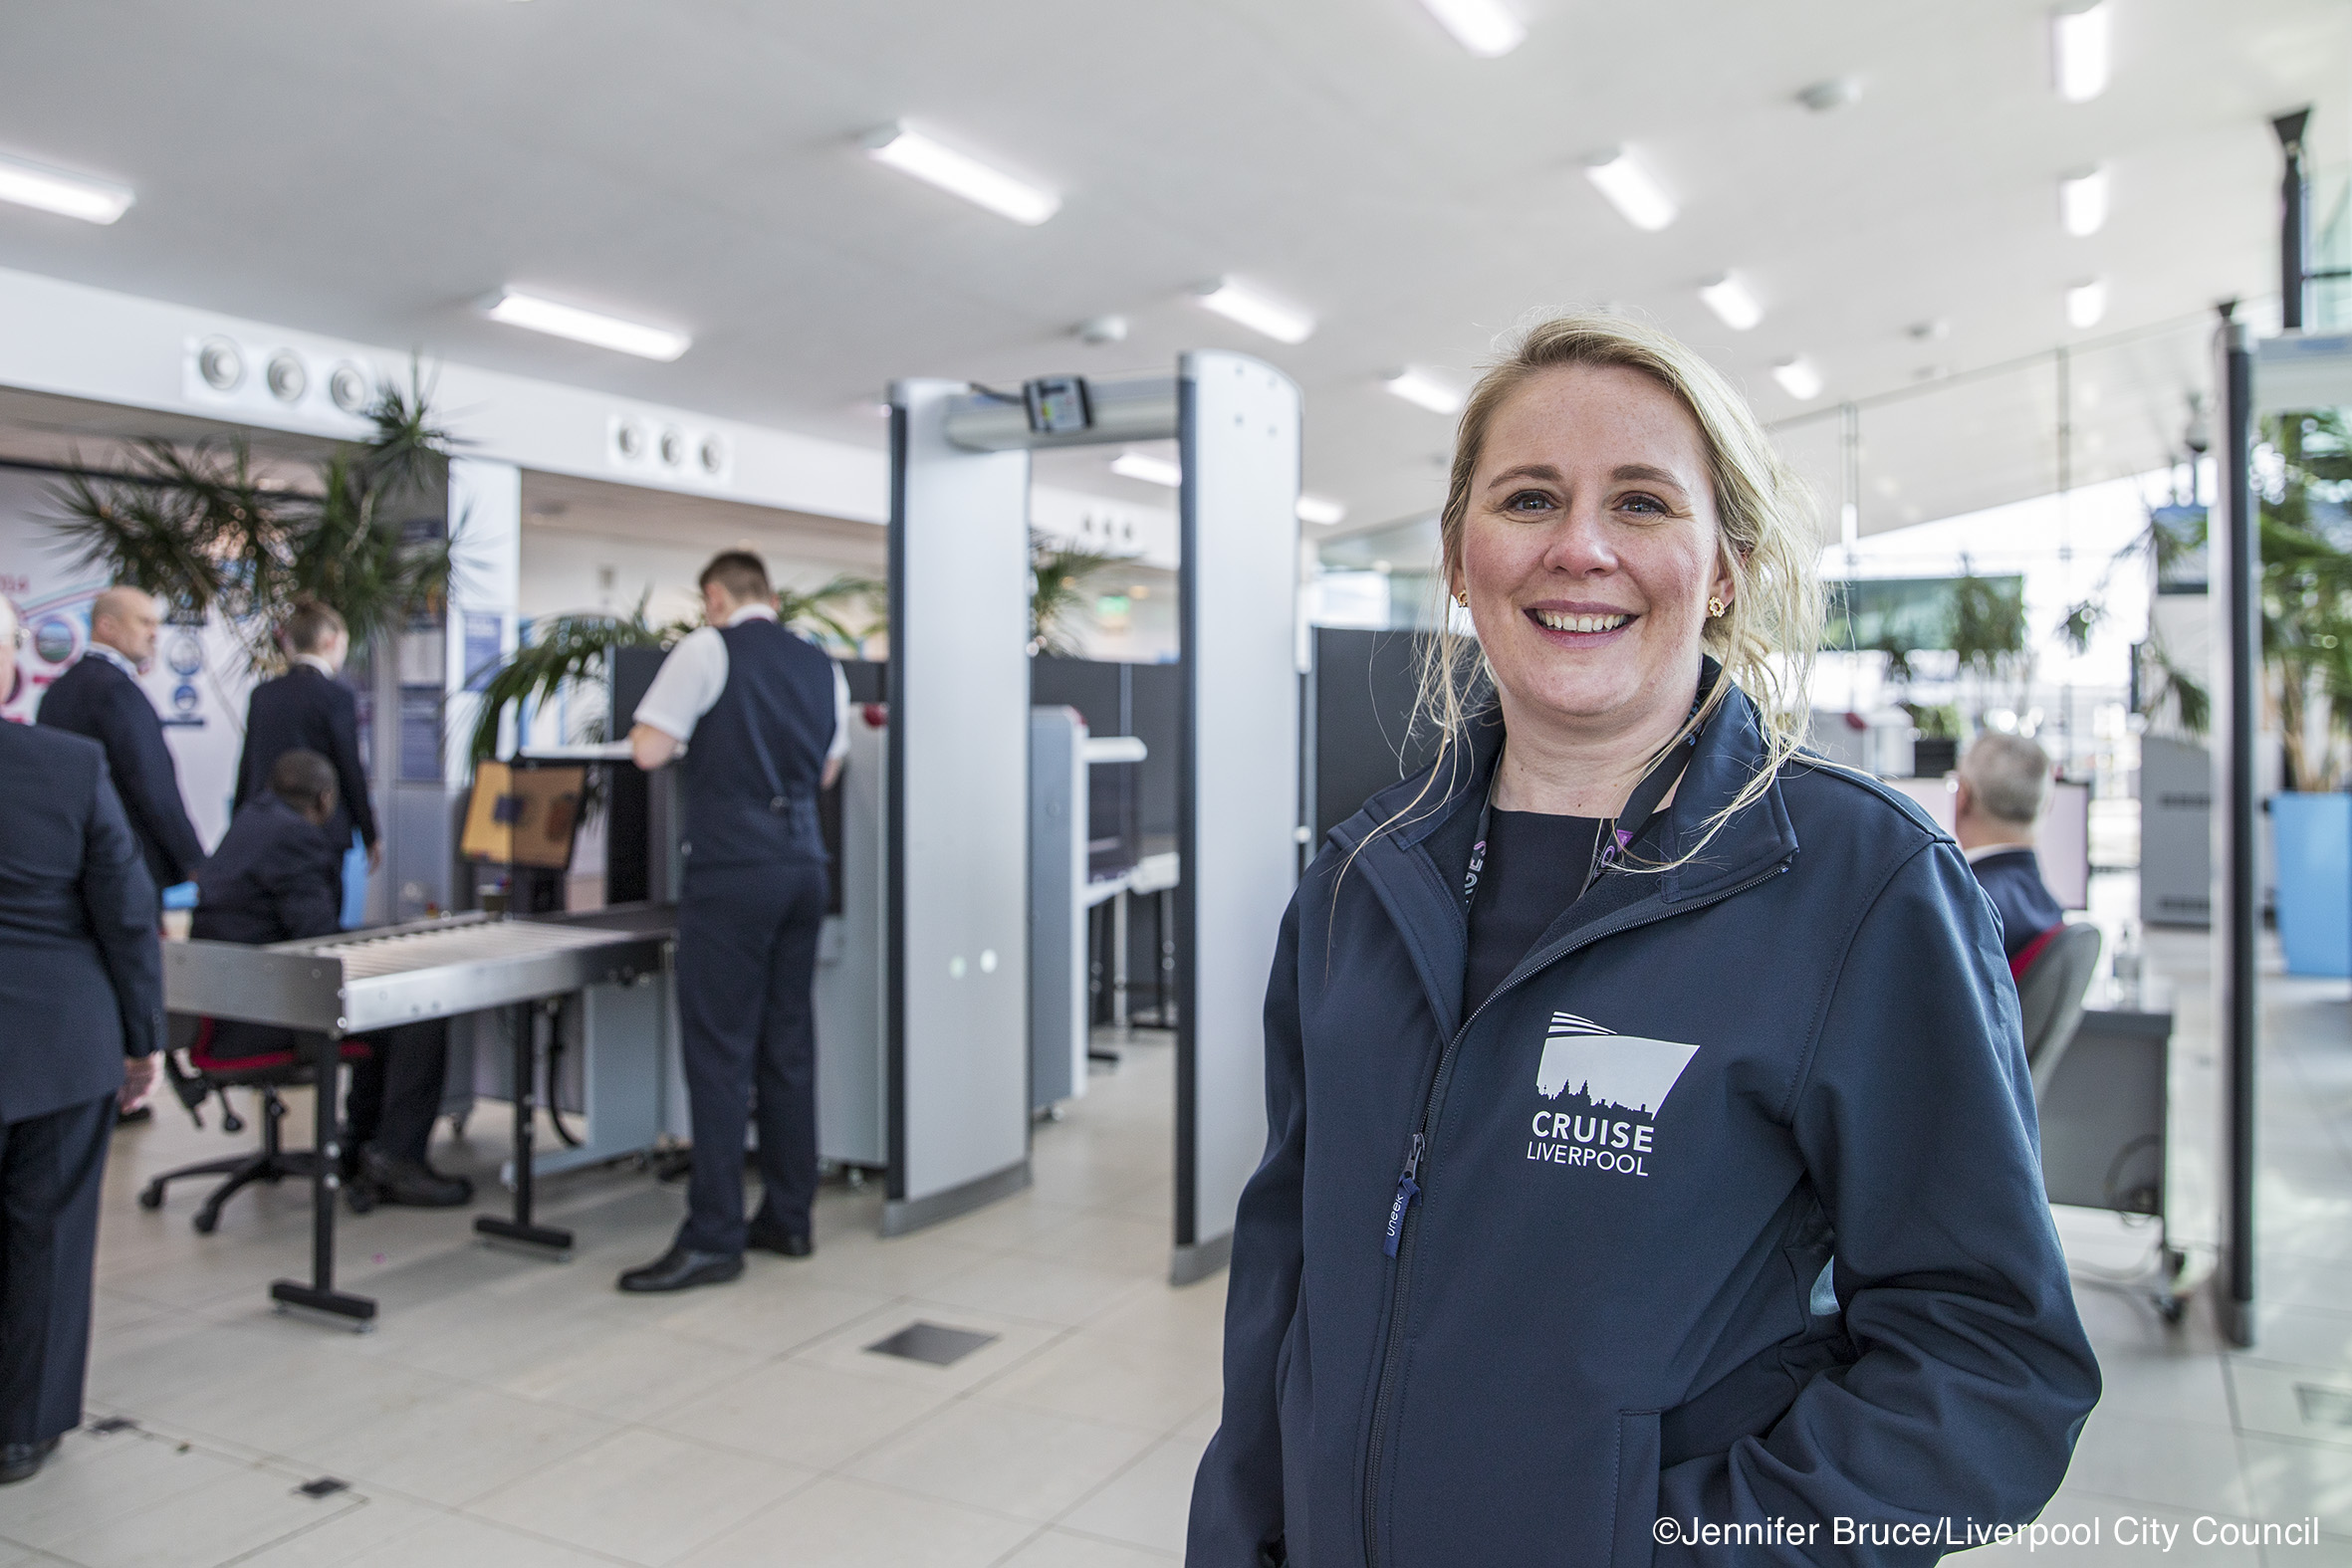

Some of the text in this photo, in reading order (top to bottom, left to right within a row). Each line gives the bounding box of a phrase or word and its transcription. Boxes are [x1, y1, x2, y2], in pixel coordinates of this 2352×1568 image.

[1531, 1110, 1655, 1154] CRUISE
[1527, 1141, 1649, 1177] LIVERPOOL
[1386, 1193, 1404, 1236] uneek
